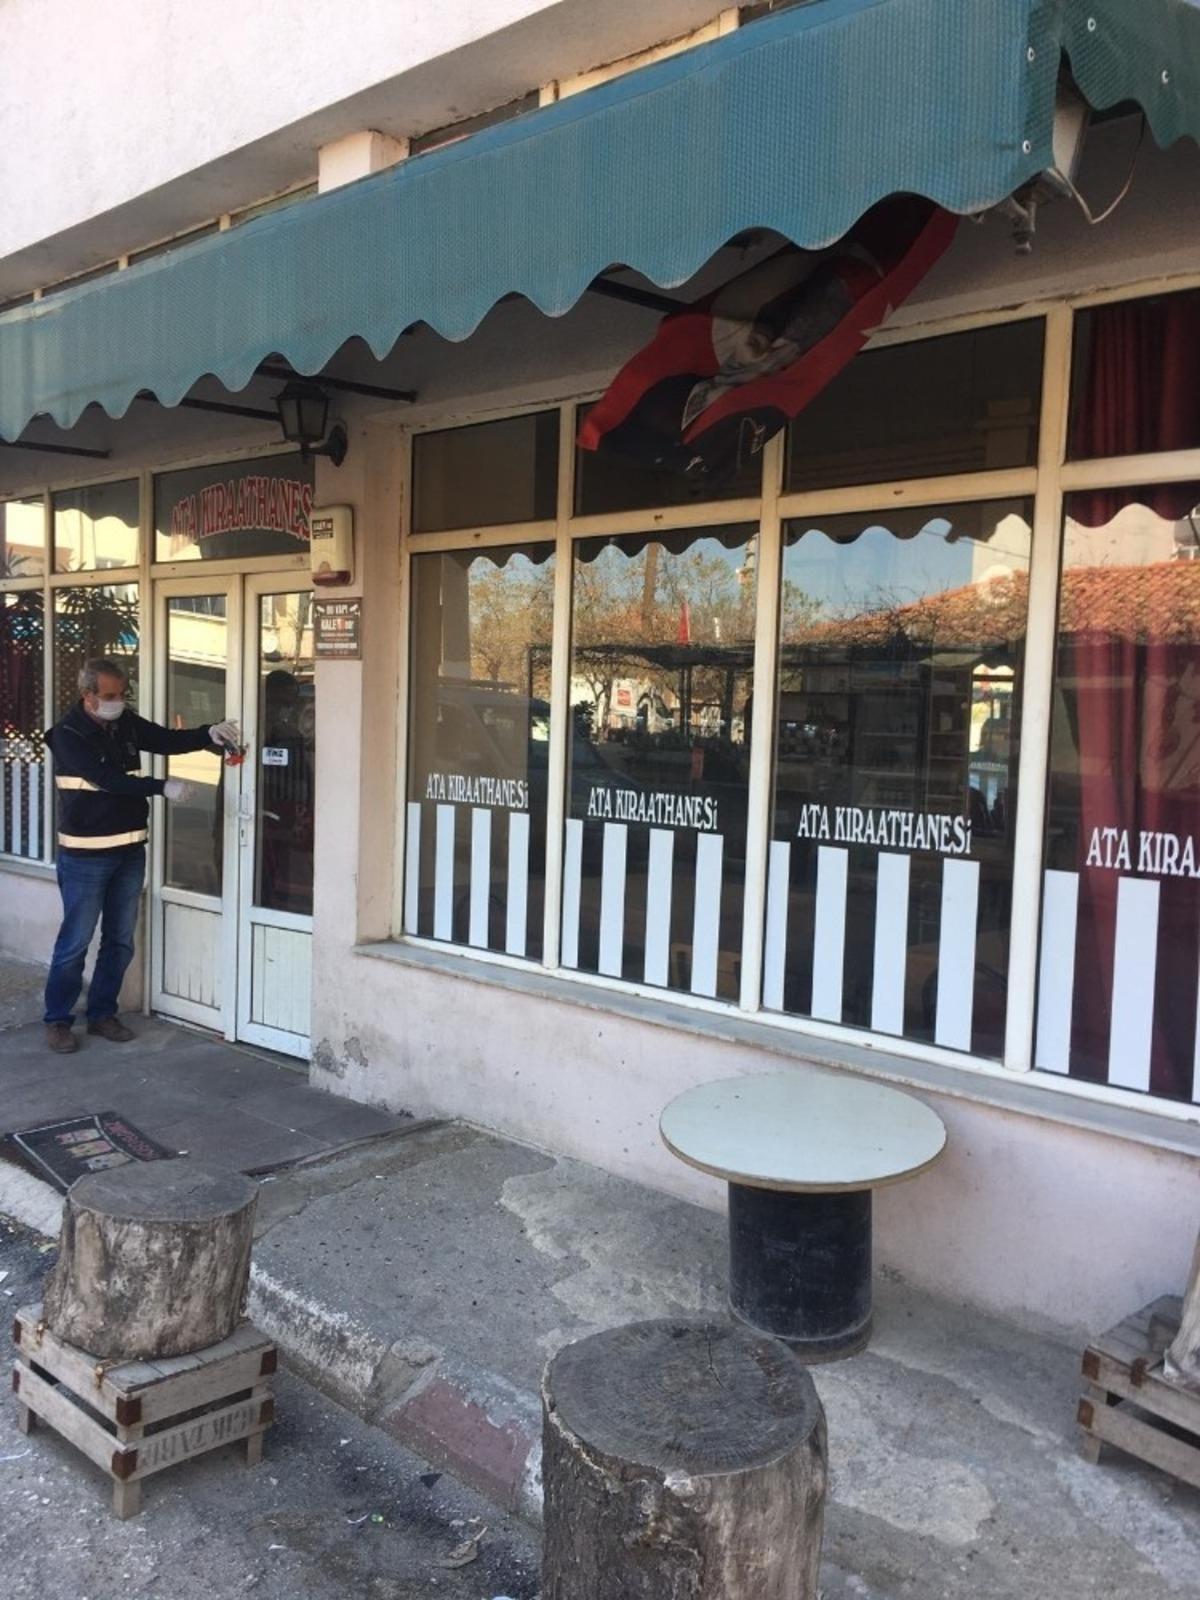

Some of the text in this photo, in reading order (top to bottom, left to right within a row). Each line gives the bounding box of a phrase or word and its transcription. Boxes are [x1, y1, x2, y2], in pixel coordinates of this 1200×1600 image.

[169, 475, 312, 553] ATA KIRAATHANES
[426, 773, 446, 800] ATA
[587, 787, 612, 818] ATA
[797, 804, 830, 840] ATA
[1086, 827, 1200, 879] ATA KIRA
